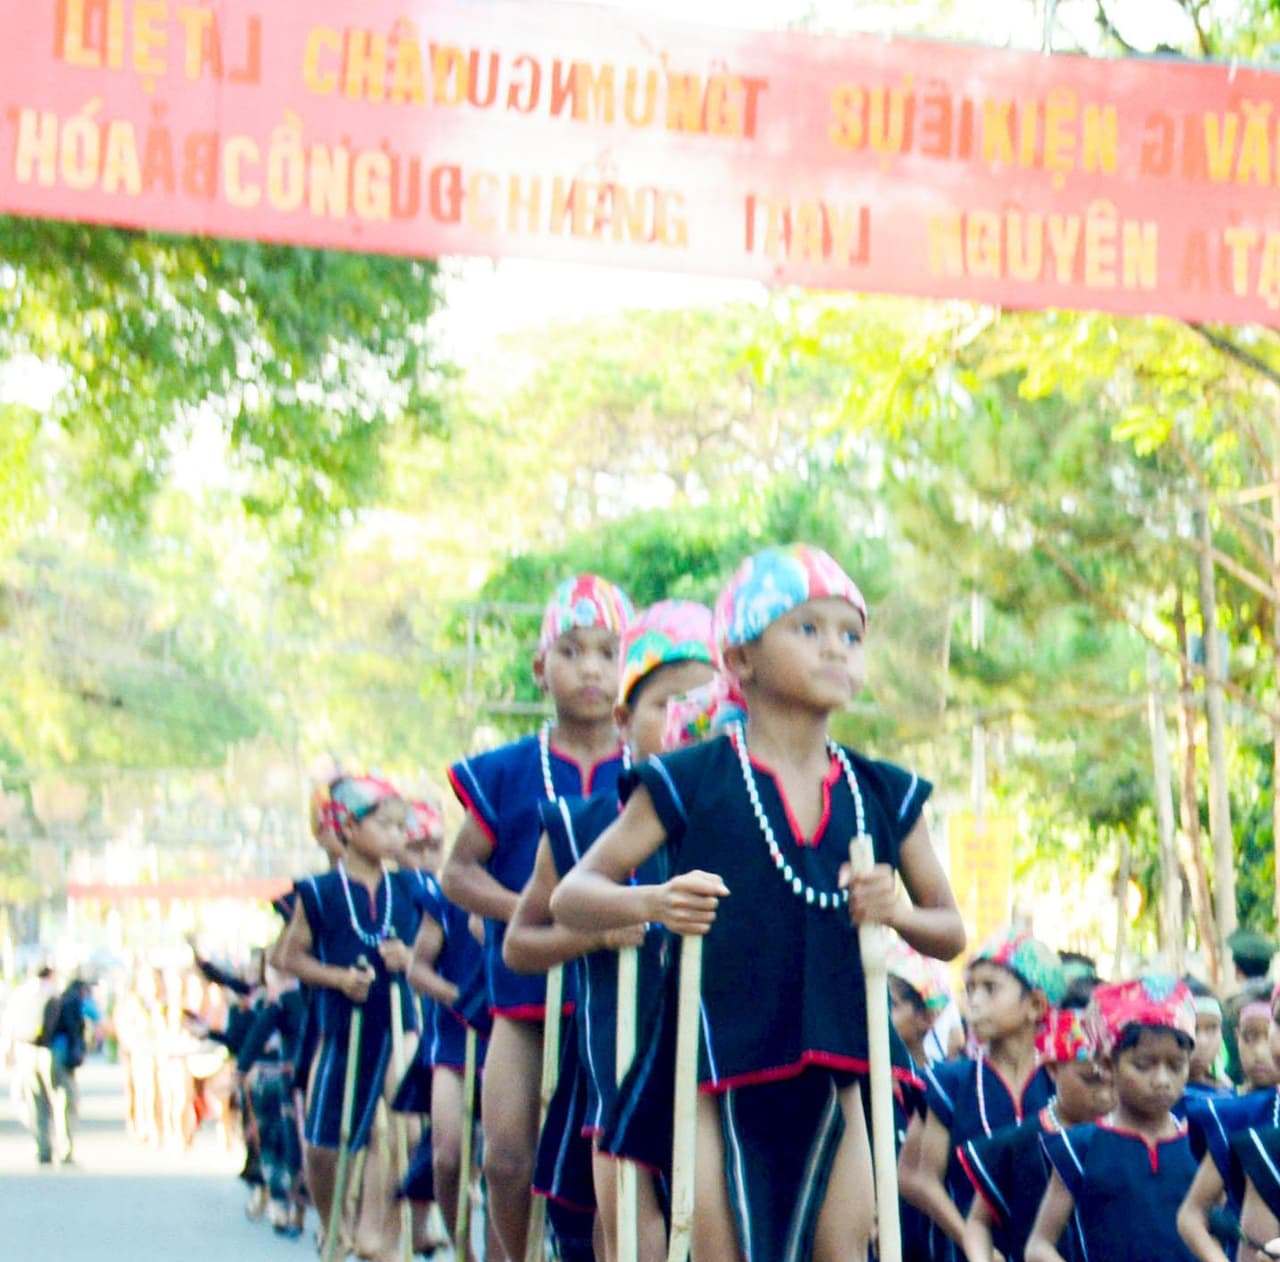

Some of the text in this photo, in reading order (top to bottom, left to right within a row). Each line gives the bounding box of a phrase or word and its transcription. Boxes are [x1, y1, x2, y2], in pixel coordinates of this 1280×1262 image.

[15, 96, 142, 196] HÓA
[223, 105, 393, 222] CỒNG
[927, 198, 1158, 289] NGUYÊN
[829, 74, 912, 174] SỰ
[983, 85, 1118, 190] KIỆN
